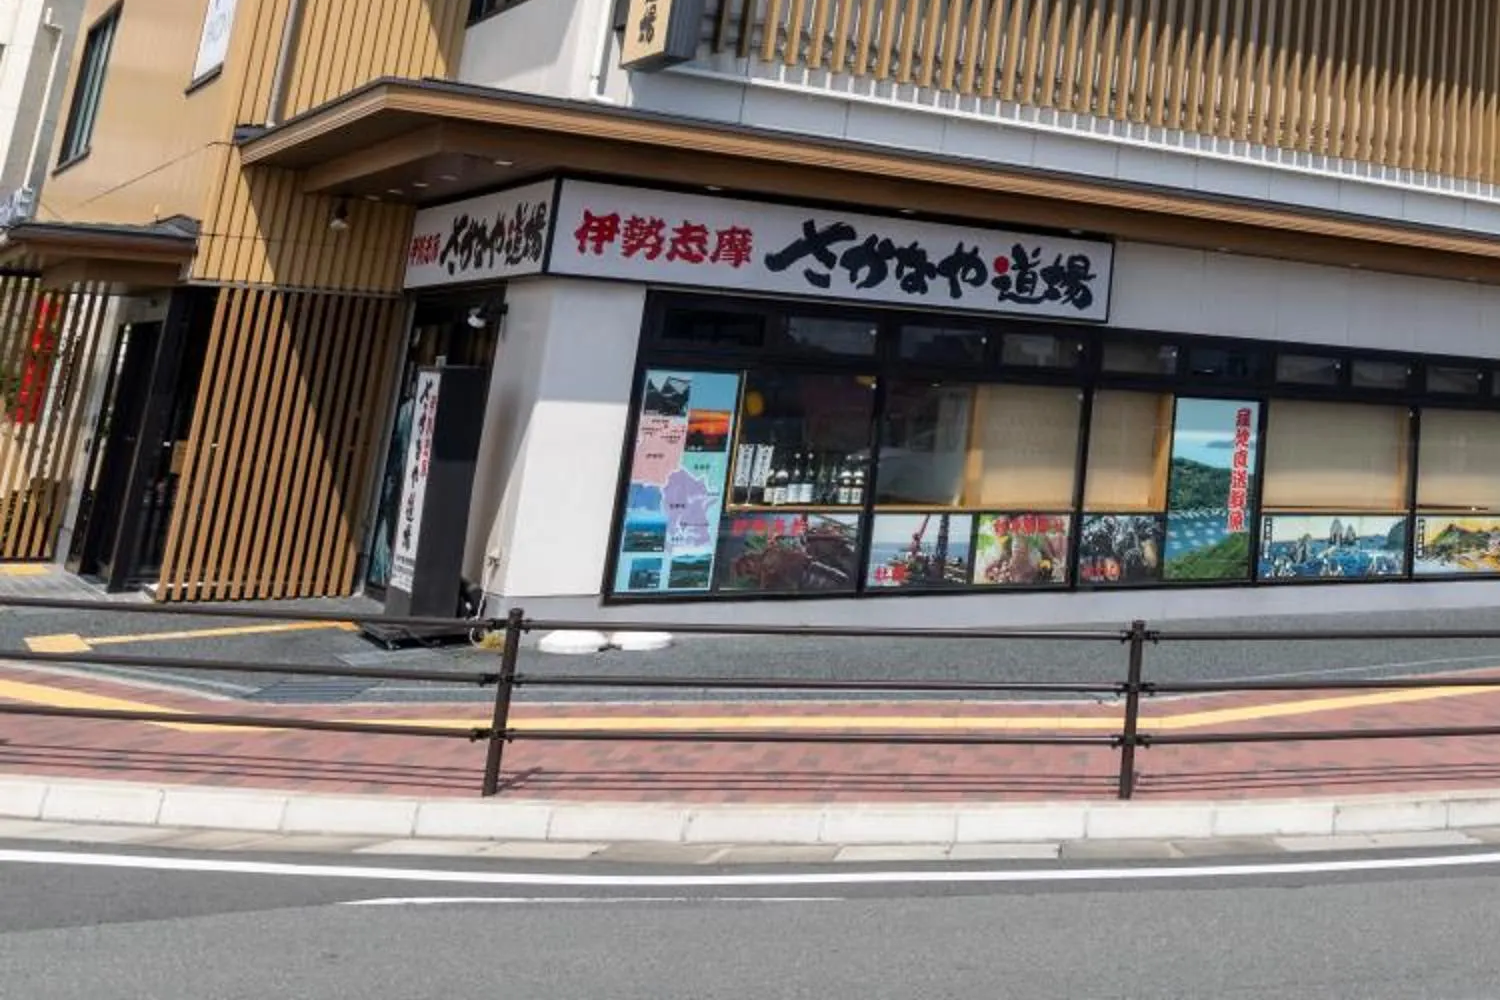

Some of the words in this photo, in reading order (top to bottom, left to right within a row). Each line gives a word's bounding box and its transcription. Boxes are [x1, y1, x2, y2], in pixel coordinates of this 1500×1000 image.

[574, 208, 753, 268] 伊勢志摩
[765, 218, 1097, 310] さかなや道場
